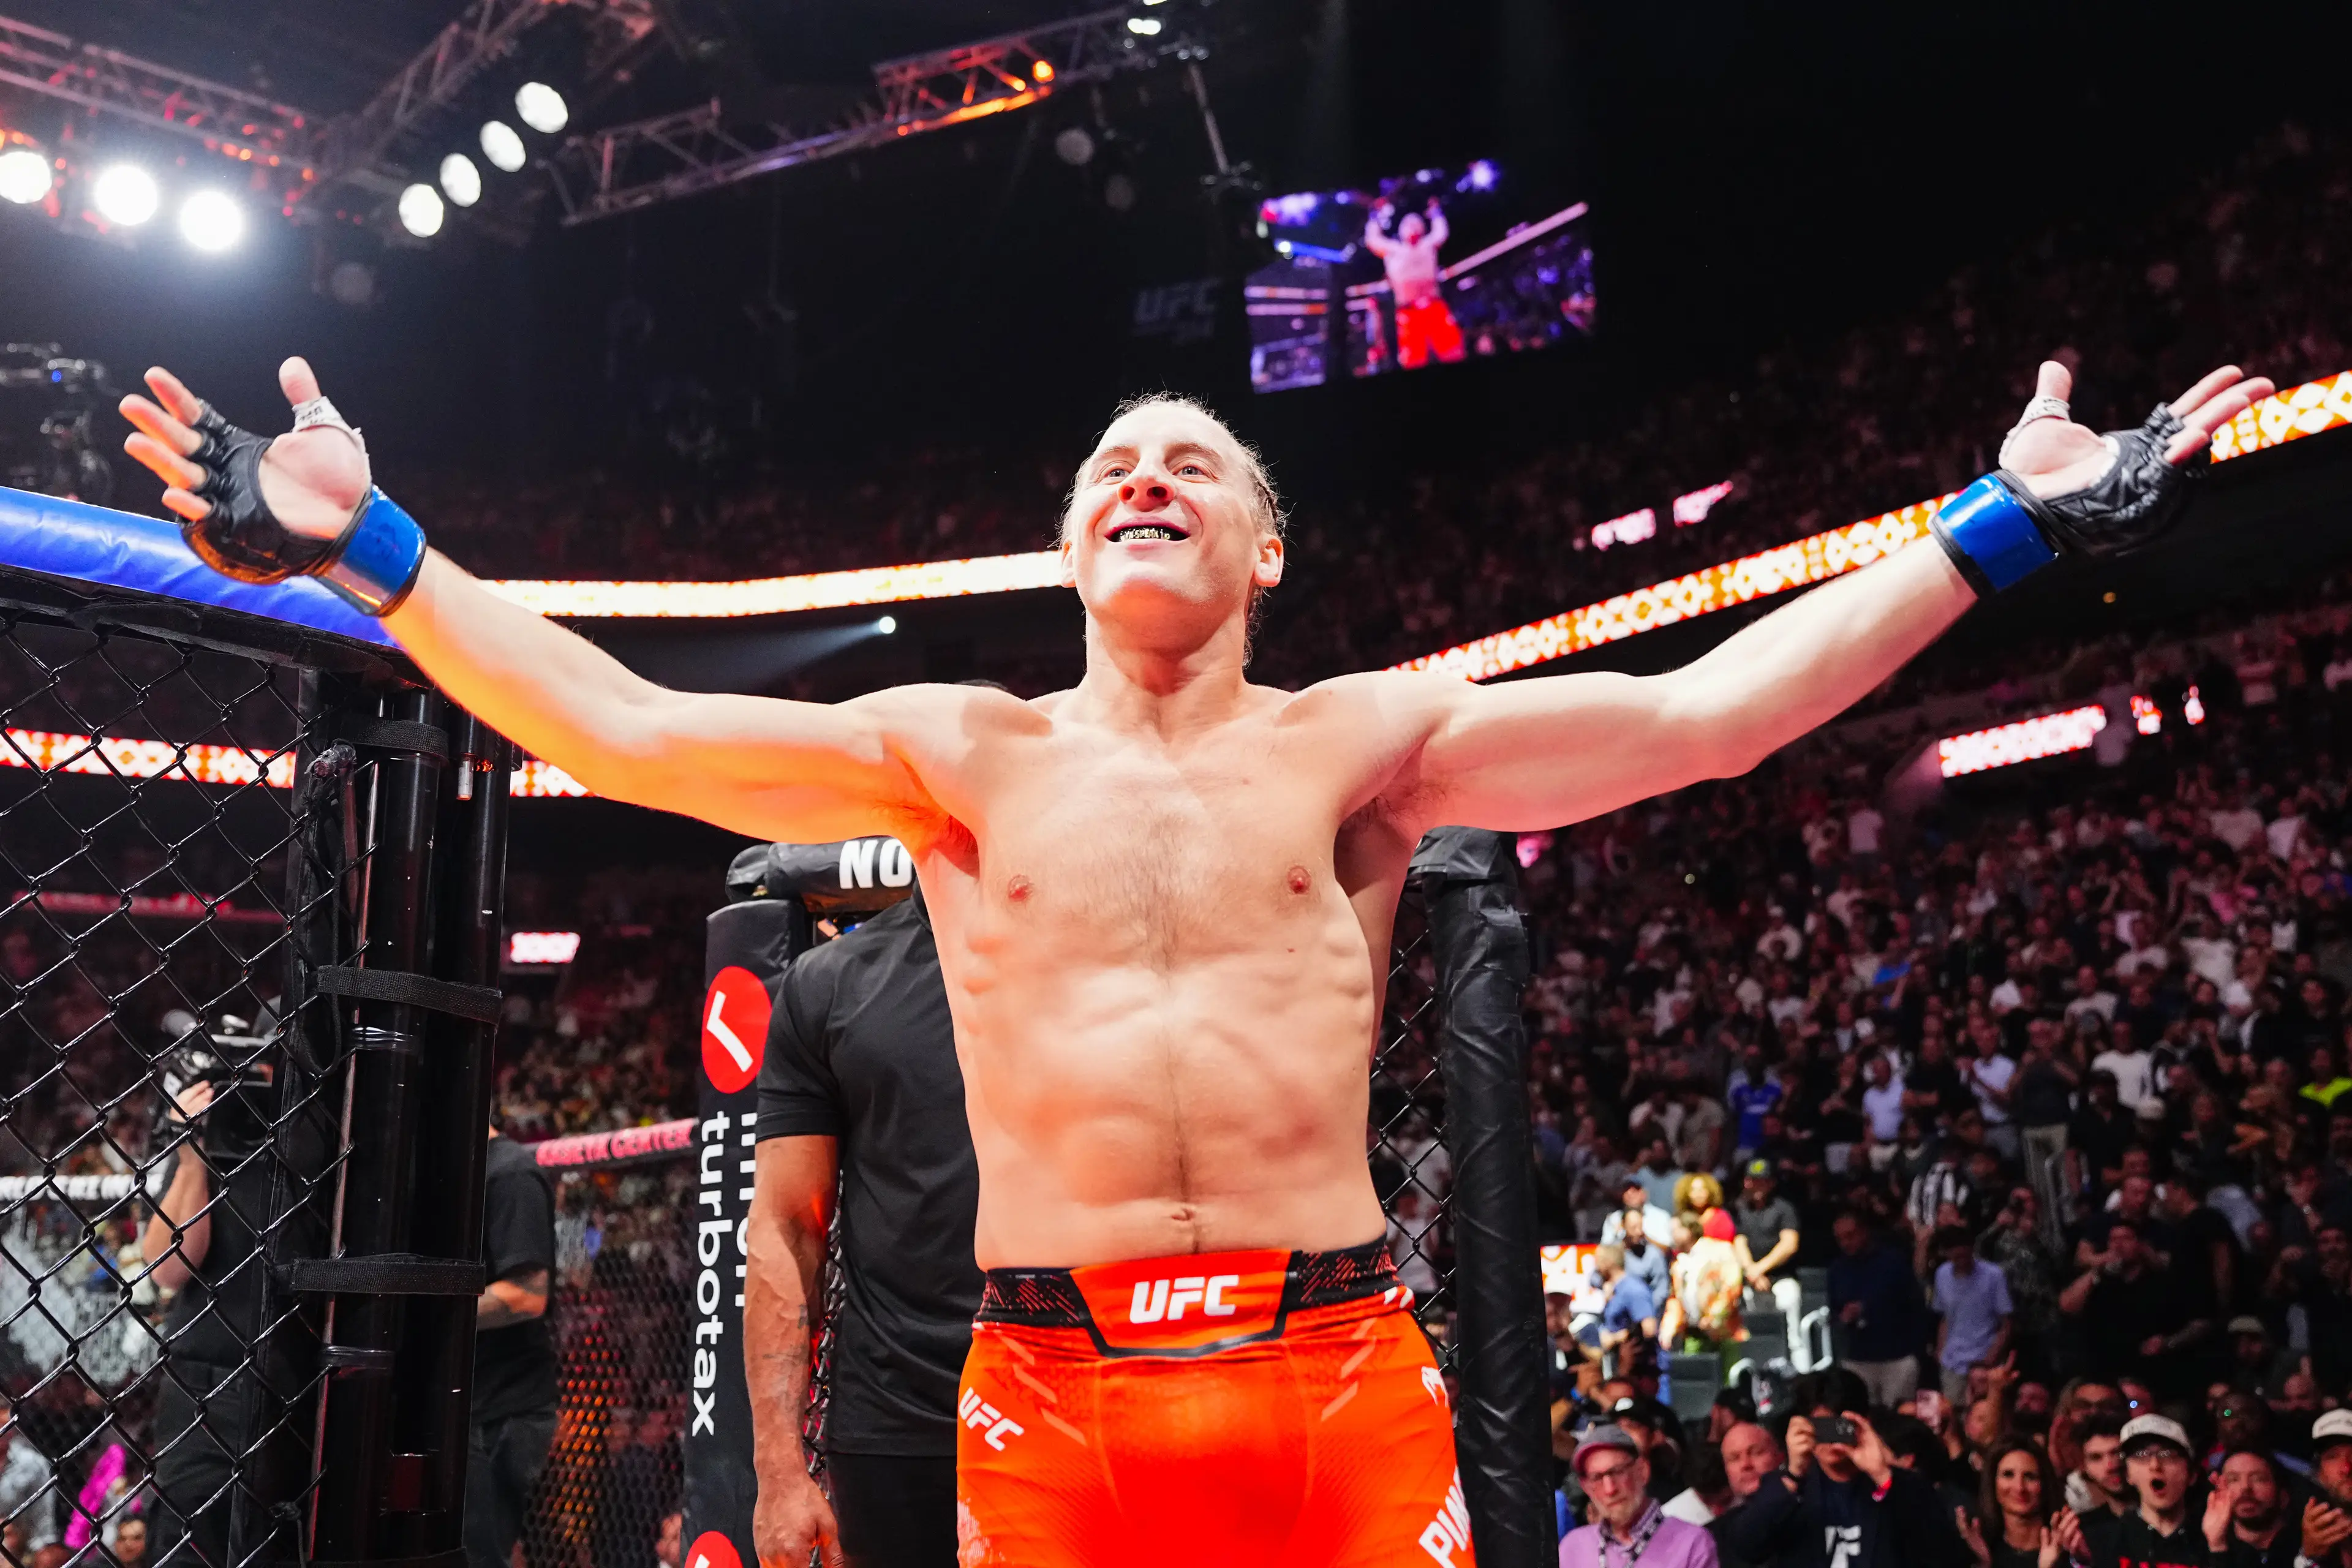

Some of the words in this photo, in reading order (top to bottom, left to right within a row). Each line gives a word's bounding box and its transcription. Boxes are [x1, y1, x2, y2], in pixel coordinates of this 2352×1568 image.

[839, 838, 913, 889] NO
[692, 1110, 733, 1437] turbotax
[1129, 1274, 1240, 1324] UFC
[959, 1386, 1025, 1452] UFC
